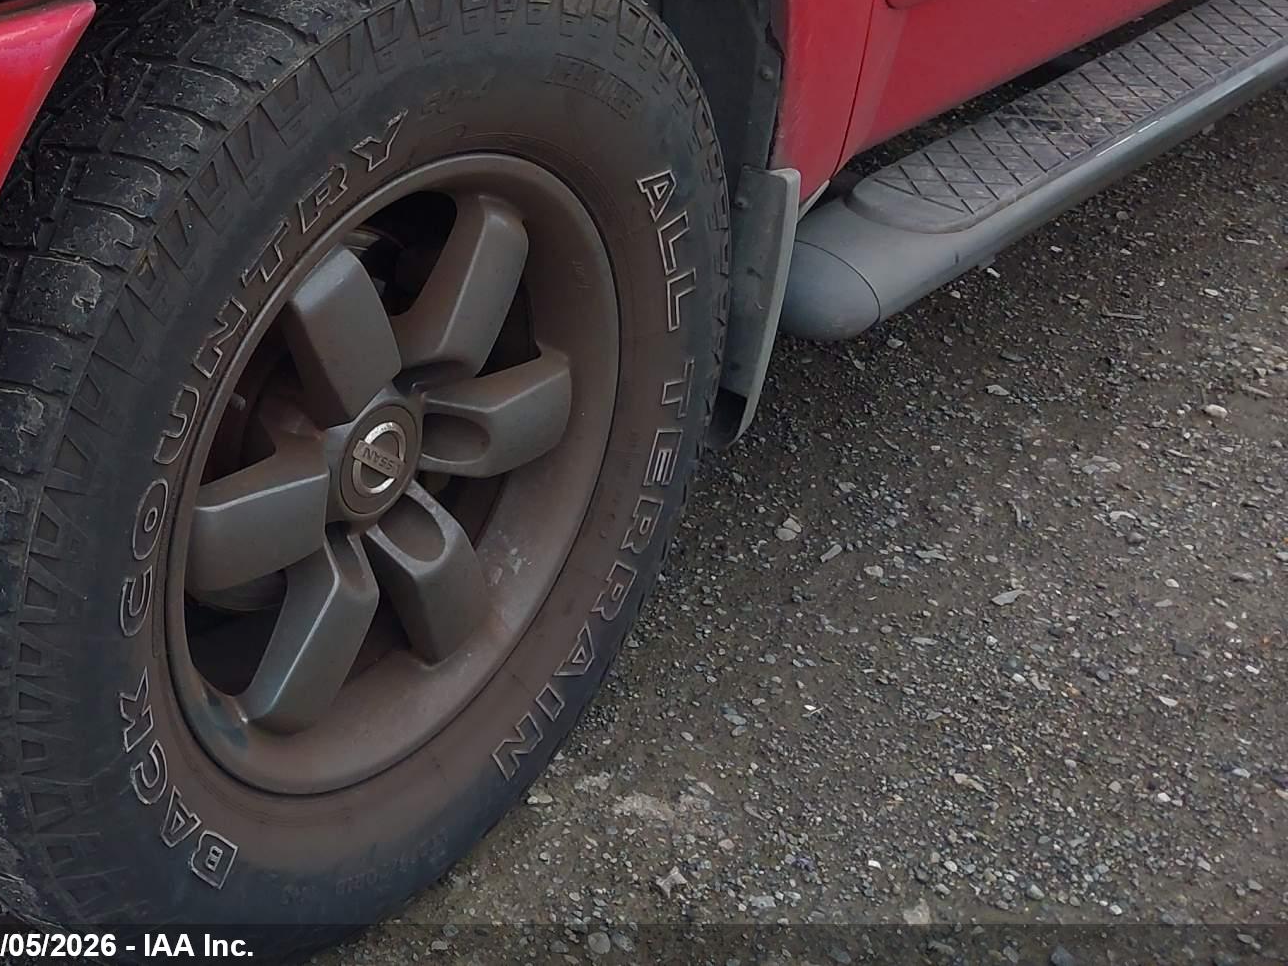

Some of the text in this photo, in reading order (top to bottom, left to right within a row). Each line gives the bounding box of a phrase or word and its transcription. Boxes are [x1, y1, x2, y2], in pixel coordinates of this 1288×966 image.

[120, 109, 409, 638] COUNTRY
[493, 169, 699, 782] ALL TERRAIN
[119, 666, 239, 890] BACK
